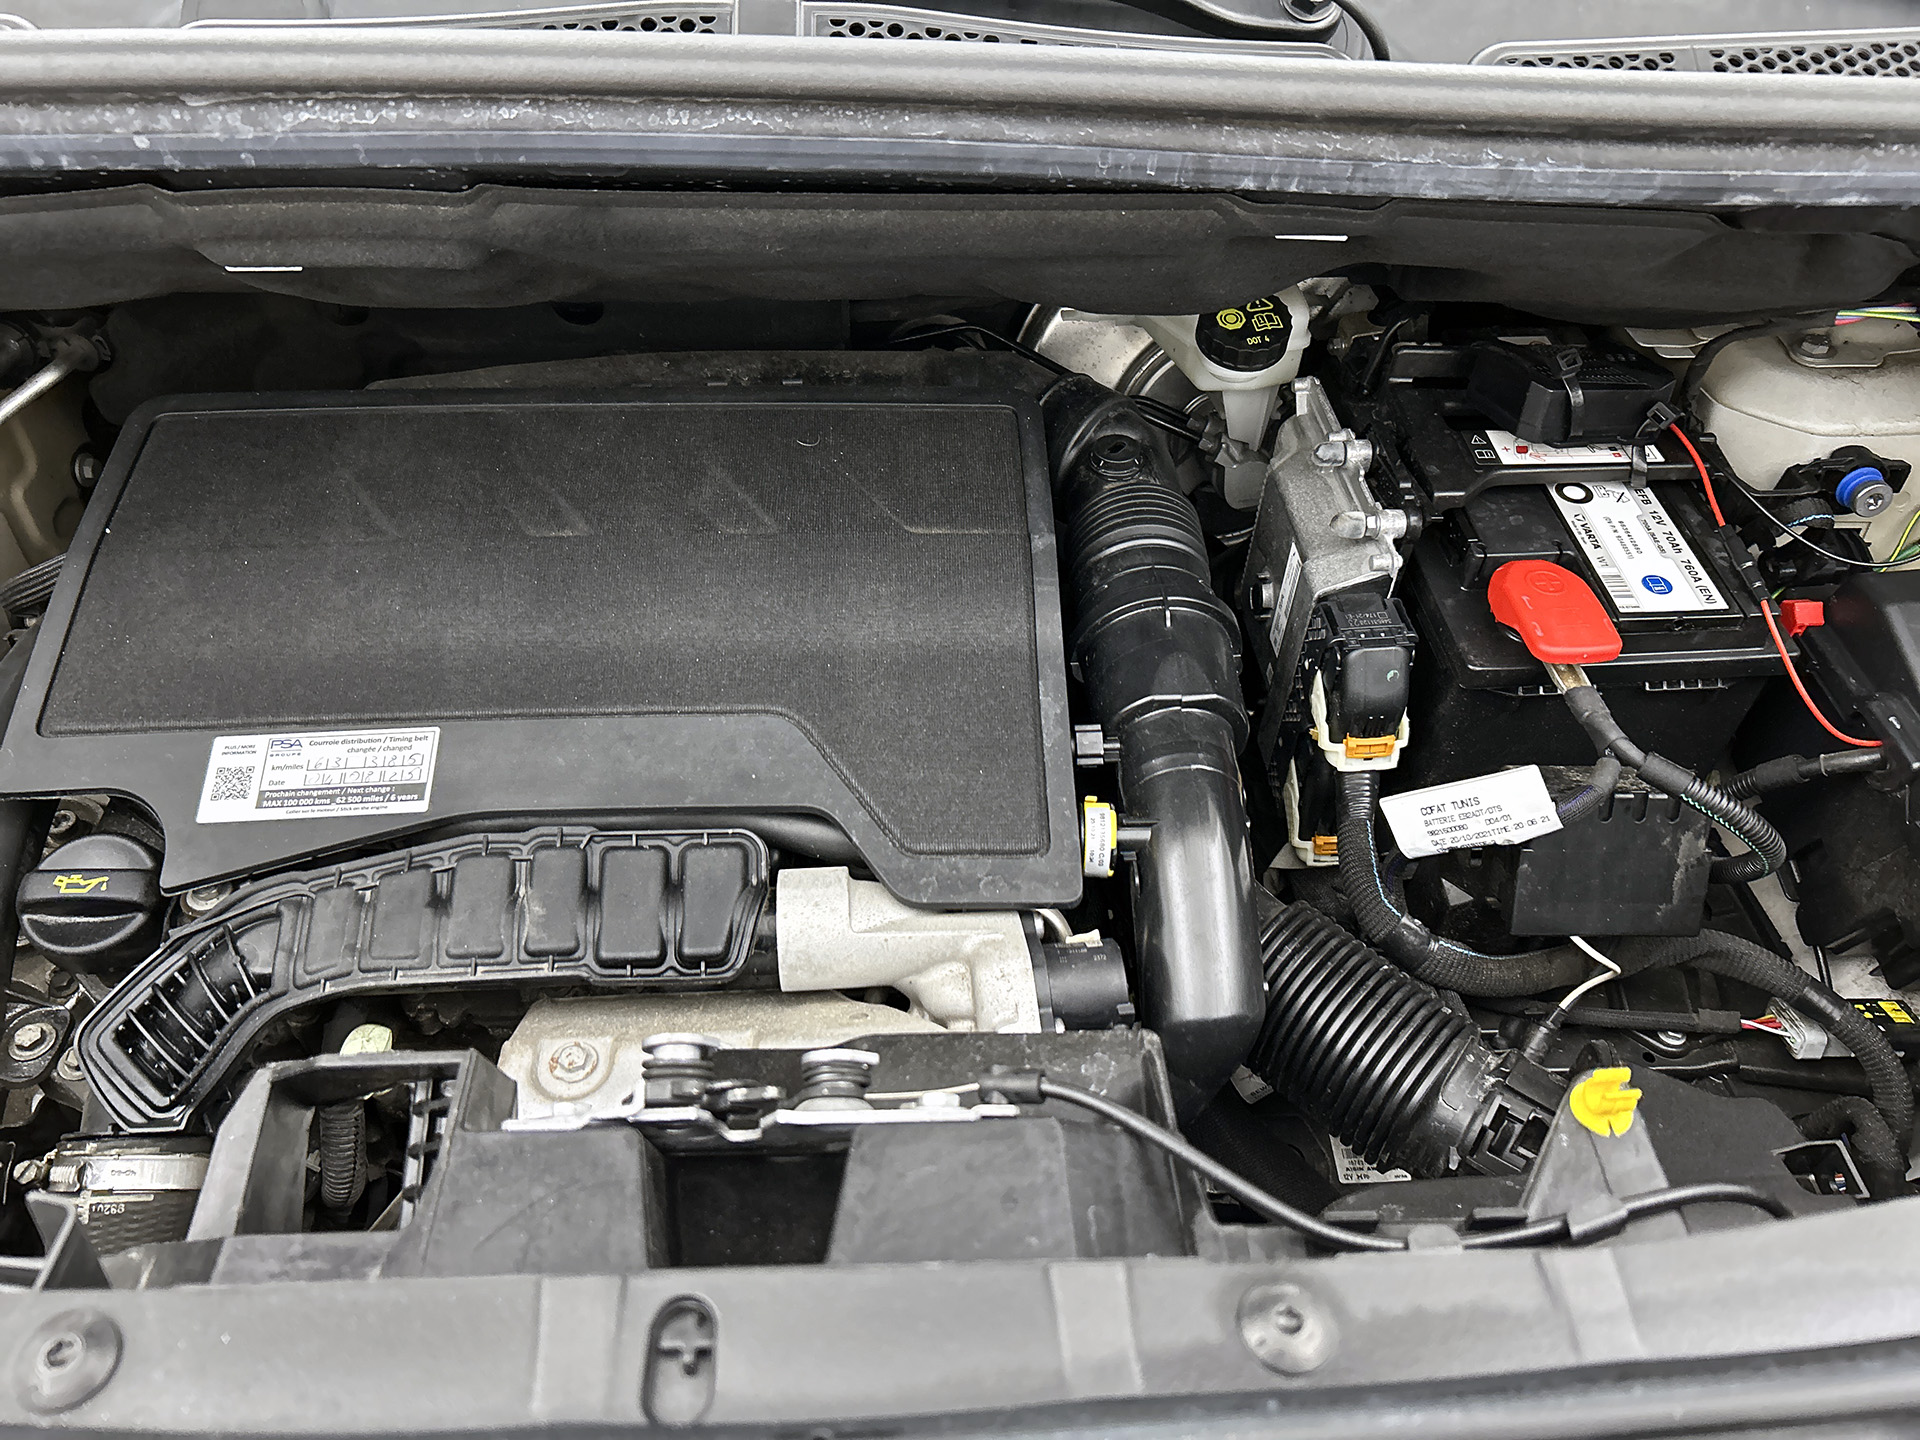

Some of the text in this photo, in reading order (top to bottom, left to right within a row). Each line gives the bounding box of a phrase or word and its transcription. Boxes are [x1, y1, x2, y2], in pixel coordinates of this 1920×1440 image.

[1246, 335, 1270, 345] DOT 4
[1580, 523, 1602, 549] VARTA
[1634, 488, 1718, 604] EFB 12V 70Ah 760A (EN)
[270, 738, 303, 749] PSA
[340, 737, 382, 745] distribution
[383, 744, 413, 752] changed
[268, 779, 286, 787] Date
[297, 788, 341, 797] changement
[347, 786, 364, 794] Next
[262, 799, 283, 807] MAX
[299, 798, 314, 806] 000
[347, 795, 362, 803] 500
[397, 793, 419, 802] years
[1420, 796, 1480, 816] COFAT TUNIS
[1424, 814, 1456, 827] BATTERIE
